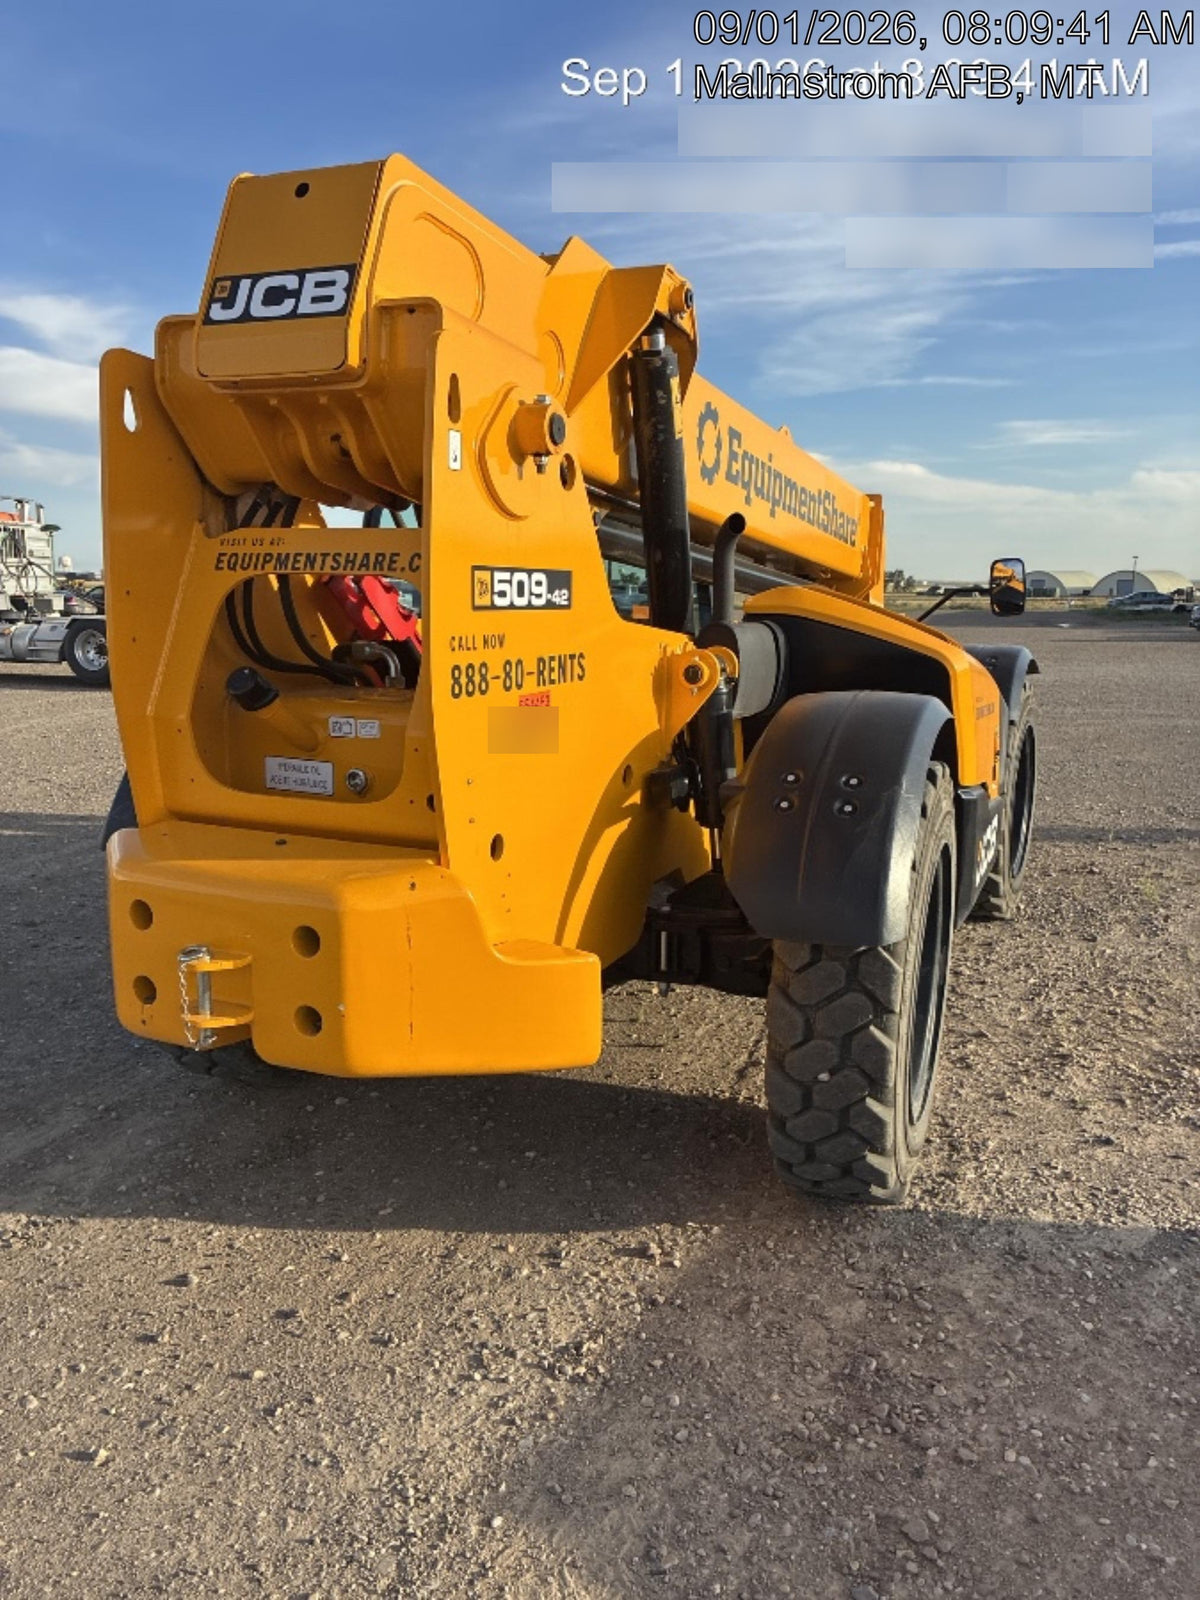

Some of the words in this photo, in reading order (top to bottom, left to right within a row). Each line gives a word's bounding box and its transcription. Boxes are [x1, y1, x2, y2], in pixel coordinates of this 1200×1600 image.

[209, 269, 350, 322] JCB
[724, 426, 858, 548] EquipmentShare
[219, 537, 247, 547] VISIT
[251, 537, 265, 547] US
[214, 552, 422, 573] EQUIPMENTSHARE.C
[449, 635, 478, 652] CALL
[482, 632, 506, 650] NOW
[450, 651, 586, 700] 888-80-RENTS
